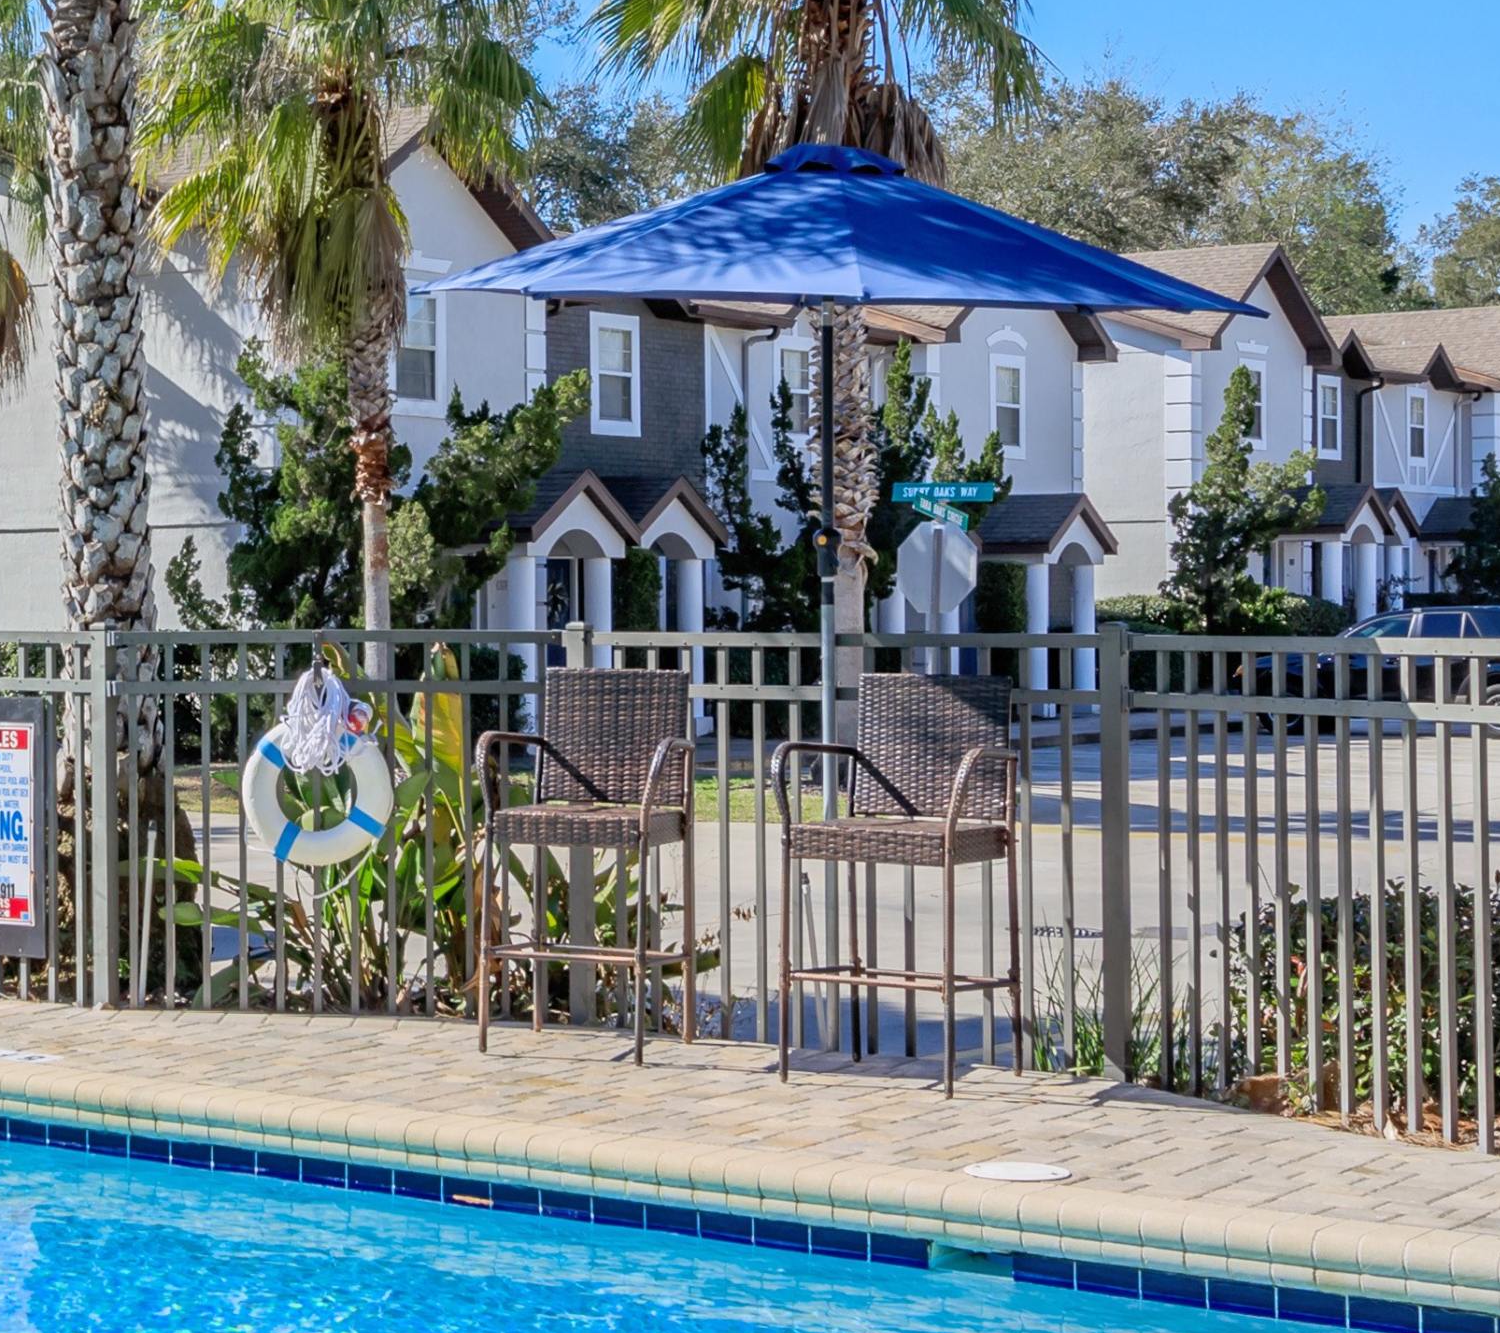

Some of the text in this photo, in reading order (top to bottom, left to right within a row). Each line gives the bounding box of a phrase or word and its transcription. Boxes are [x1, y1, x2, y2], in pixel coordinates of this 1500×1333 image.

[934, 486, 956, 498] OAKS
[960, 486, 978, 498] WAY
[0, 883, 15, 898] 911
